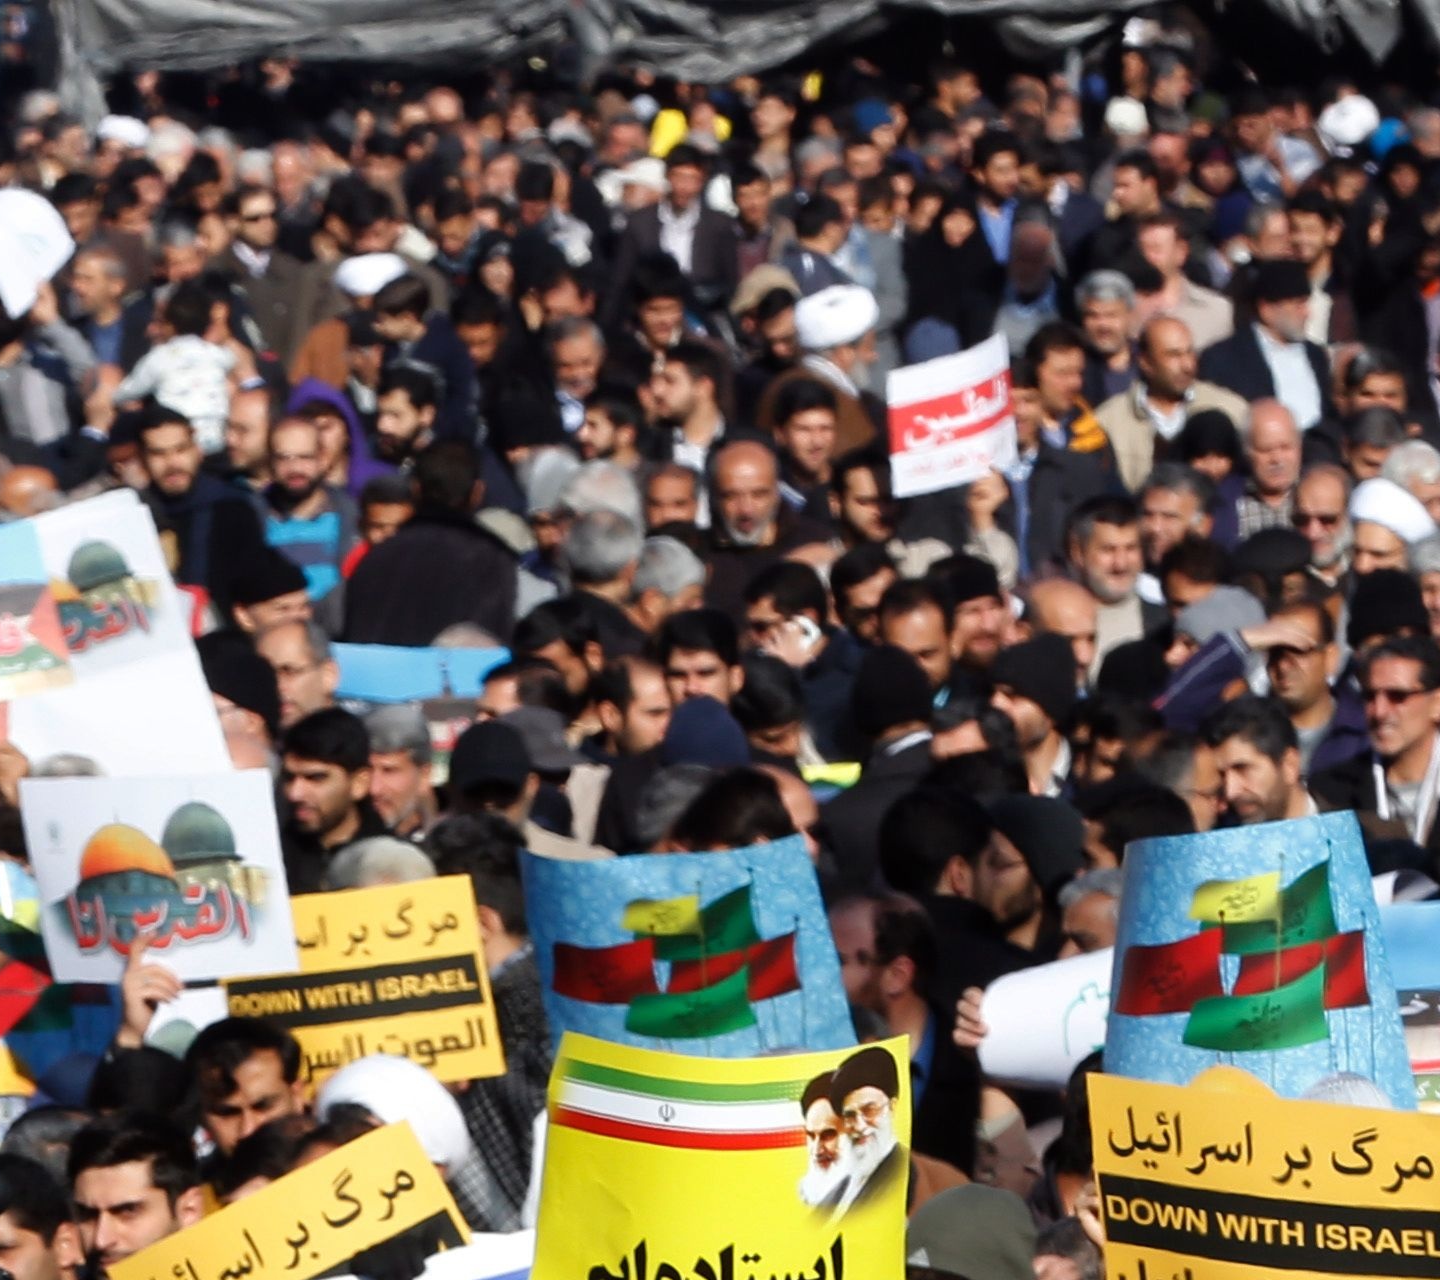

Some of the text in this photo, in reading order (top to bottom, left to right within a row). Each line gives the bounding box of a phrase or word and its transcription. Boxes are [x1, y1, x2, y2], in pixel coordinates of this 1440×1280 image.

[229, 970, 476, 1016] DOWN WITH ISRAEL
[1107, 1111, 1433, 1194] مرگ بر اسرائیل
[1107, 1195, 1210, 1238] DOWN
[1216, 1209, 1305, 1248] WITH
